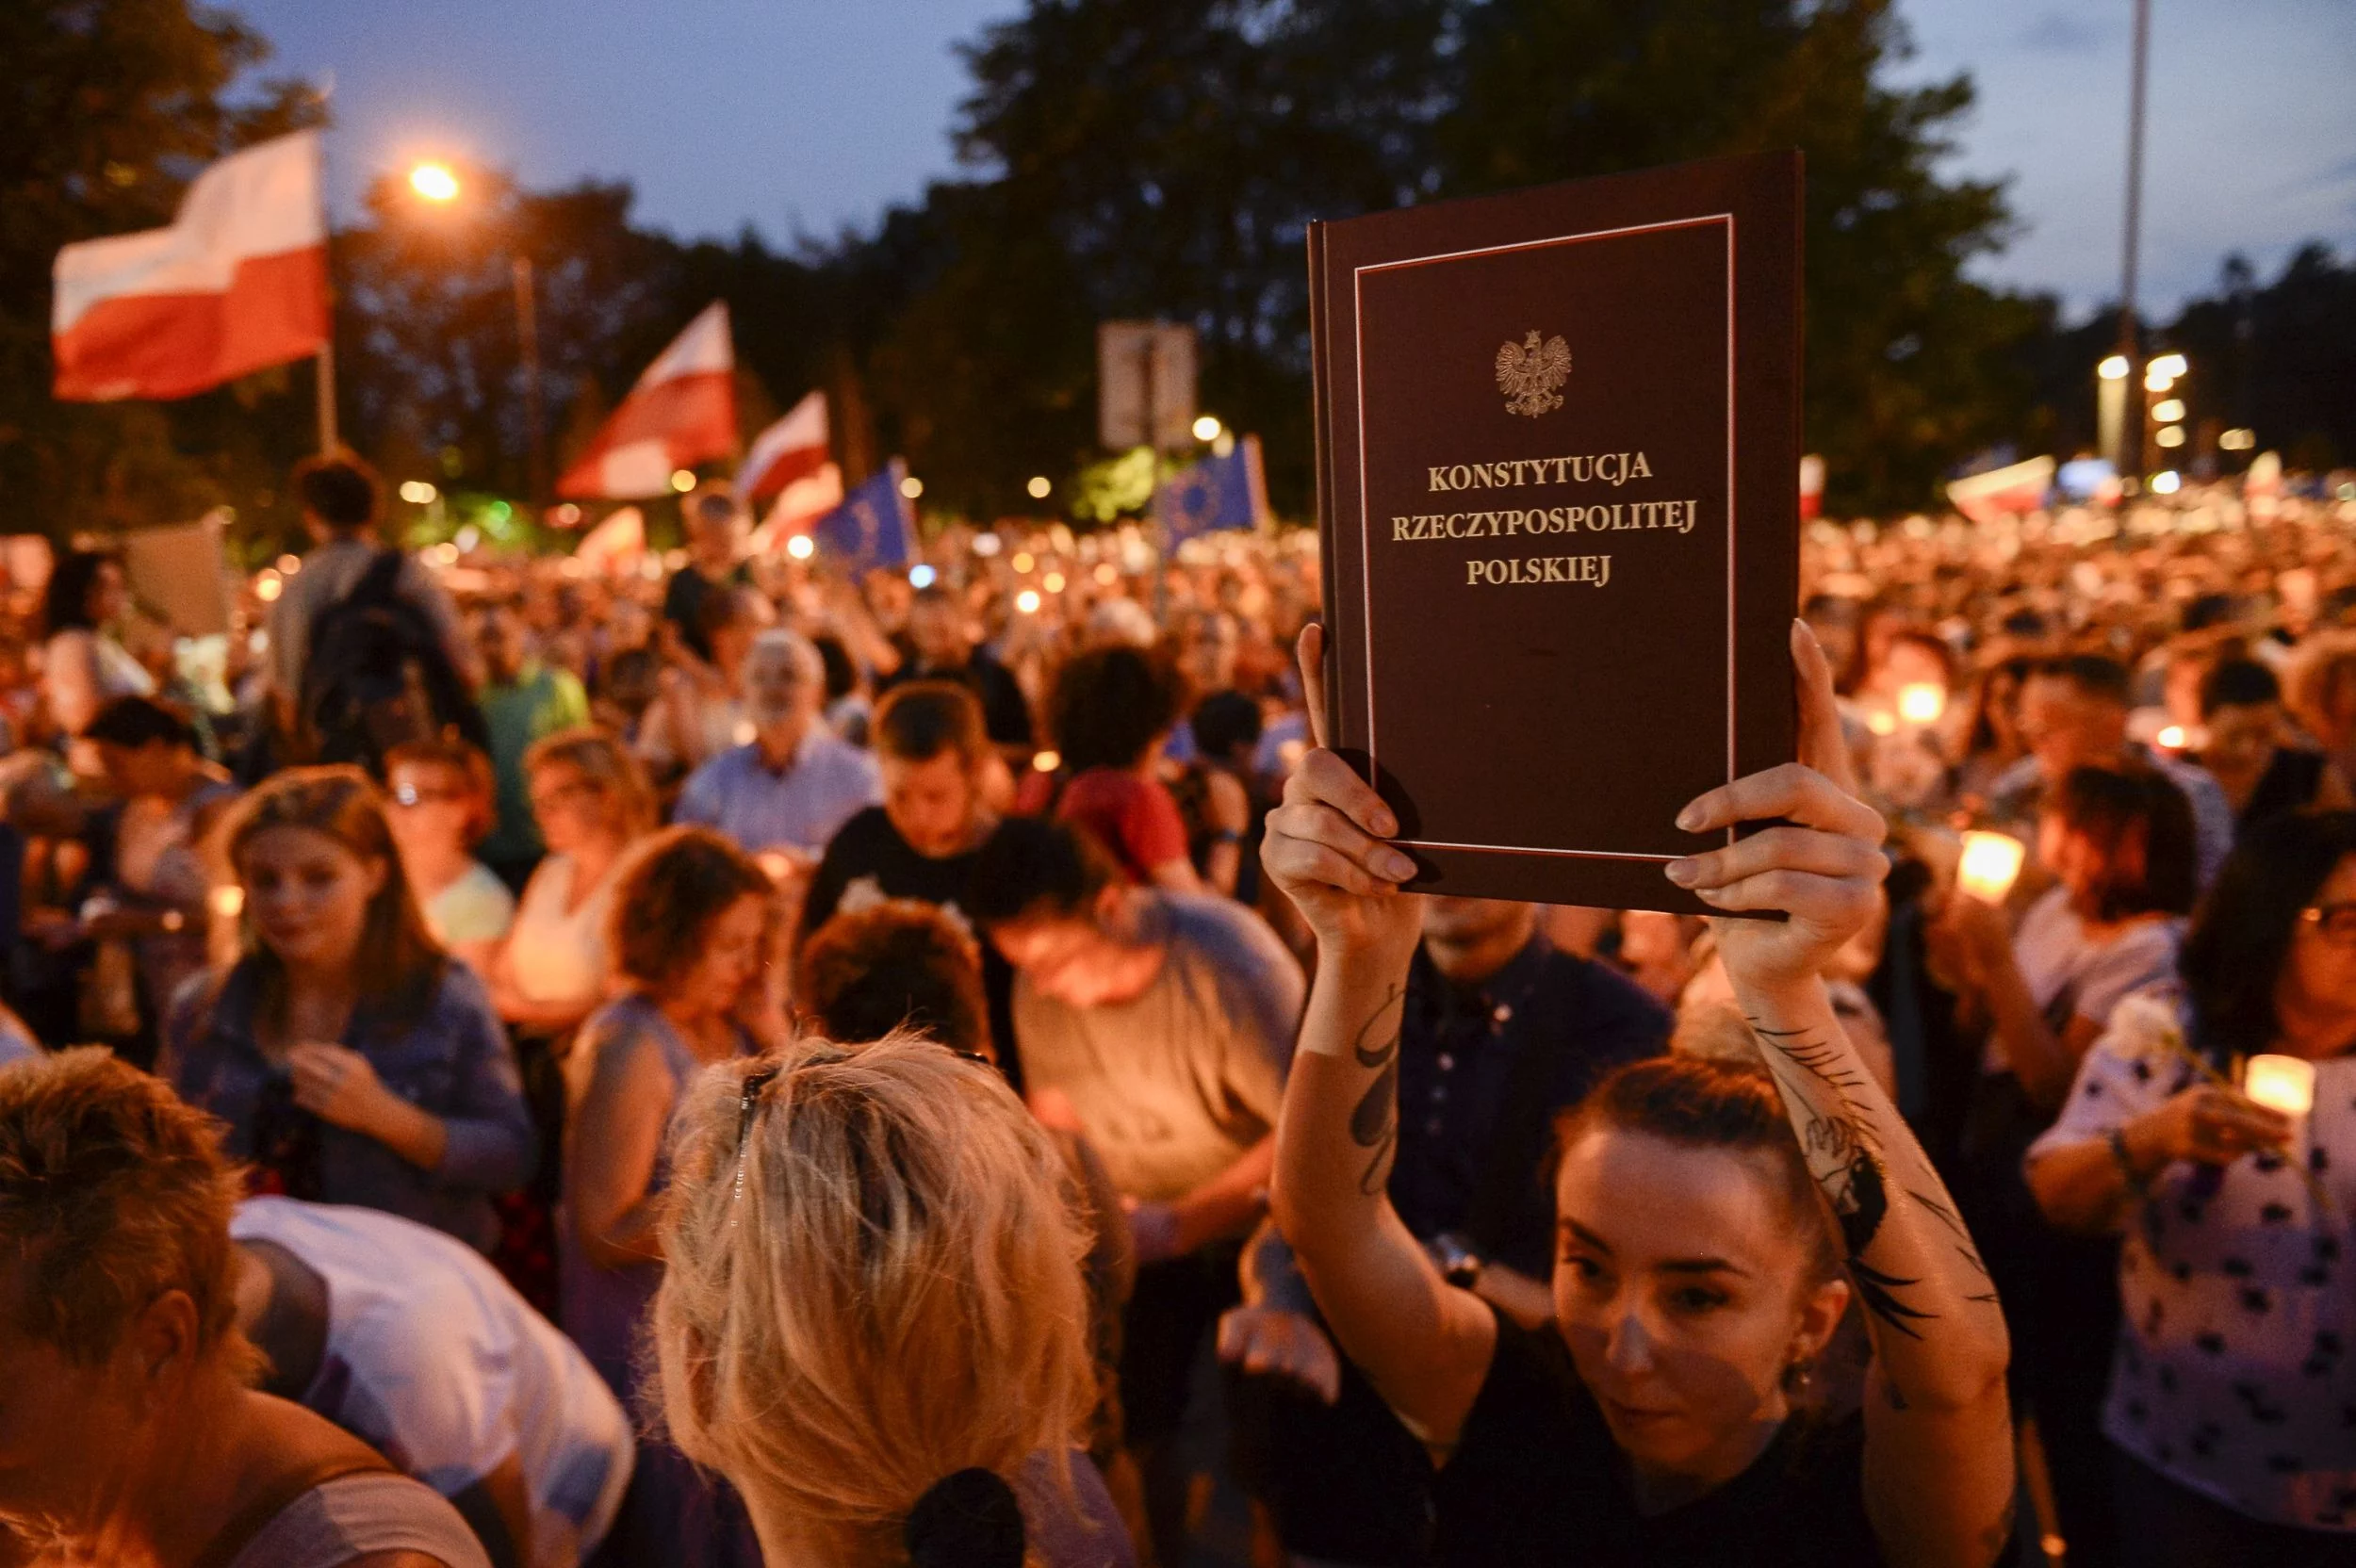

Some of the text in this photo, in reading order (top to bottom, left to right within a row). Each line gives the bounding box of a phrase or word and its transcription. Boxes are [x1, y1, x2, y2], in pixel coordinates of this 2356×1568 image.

[1428, 451, 1653, 492] KONSTYTUCJA
[1391, 499, 1697, 542] RZECZYPOSPOLITEJ
[1465, 554, 1612, 588] POLSKIEJ
